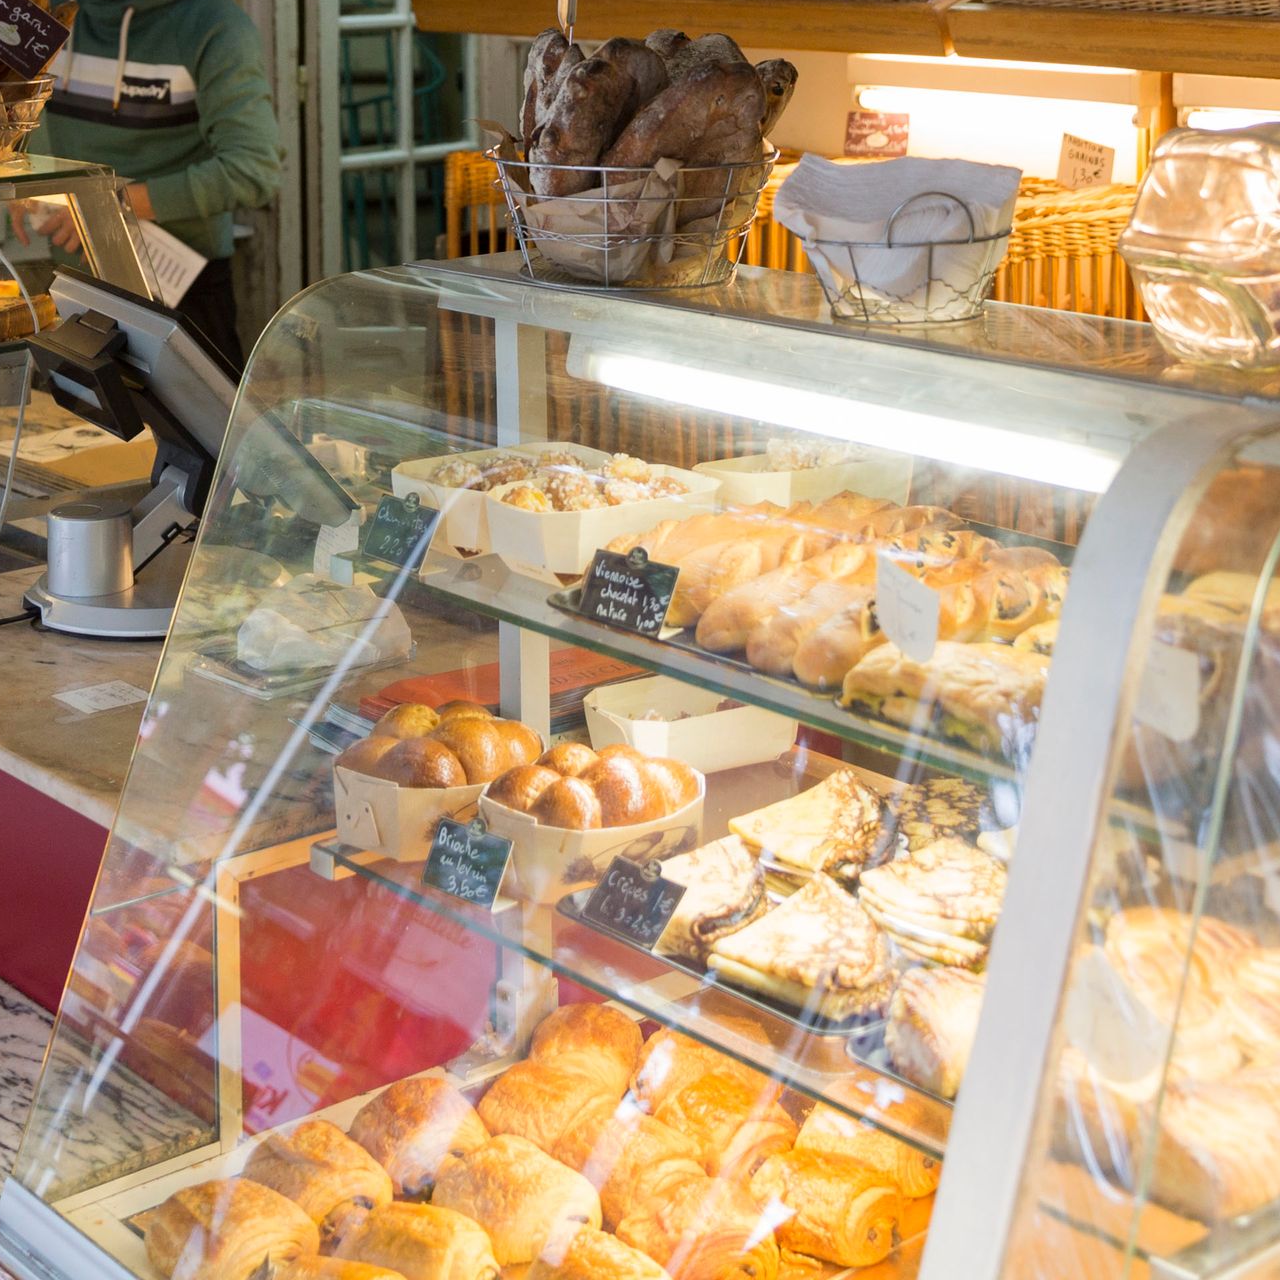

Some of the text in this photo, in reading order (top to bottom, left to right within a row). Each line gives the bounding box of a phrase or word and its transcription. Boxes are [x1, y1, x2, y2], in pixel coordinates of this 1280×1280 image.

[9, 6, 50, 36] garni
[600, 582, 639, 606] chocolat
[438, 826, 480, 859] Brioche
[447, 875, 488, 898] 3,50€
